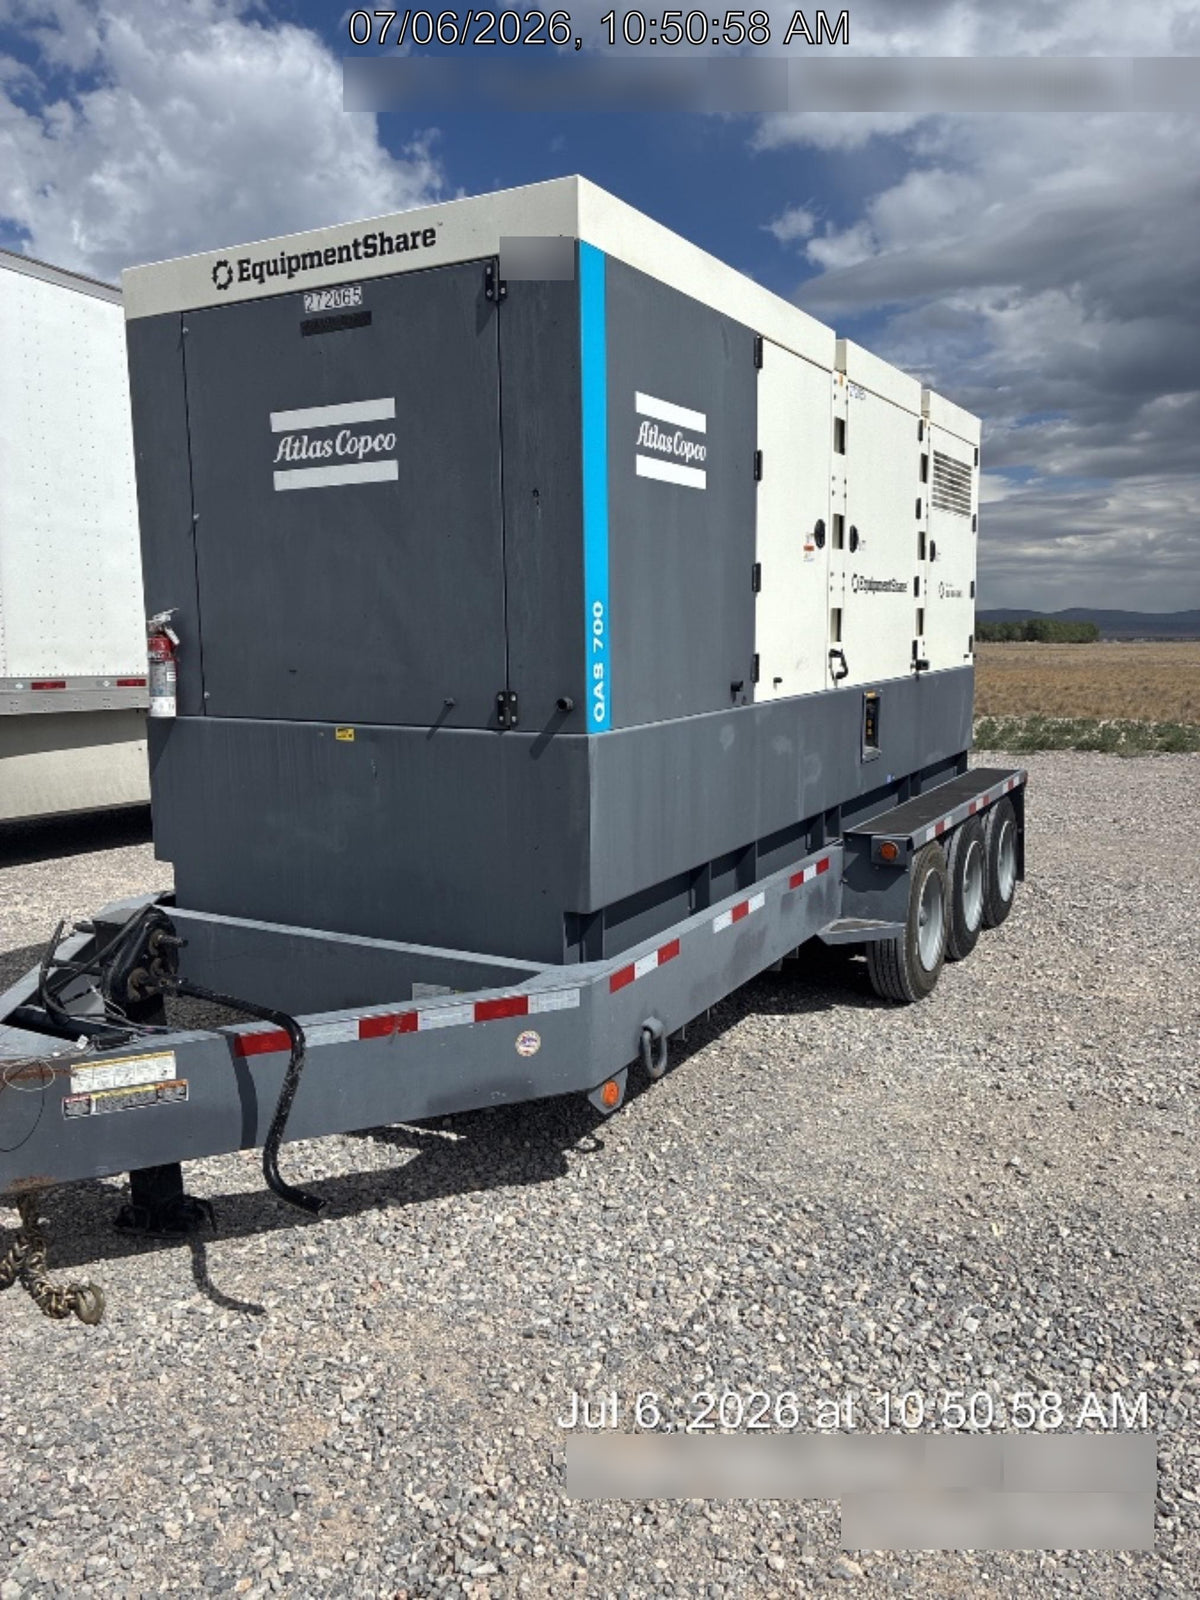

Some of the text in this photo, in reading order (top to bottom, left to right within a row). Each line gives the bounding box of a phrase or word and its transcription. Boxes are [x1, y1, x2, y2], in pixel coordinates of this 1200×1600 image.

[237, 227, 436, 284] EquipmentShare
[272, 429, 397, 463] Atlas Copco
[636, 420, 707, 463] Atlas Copco
[592, 601, 605, 722] QAS 700
